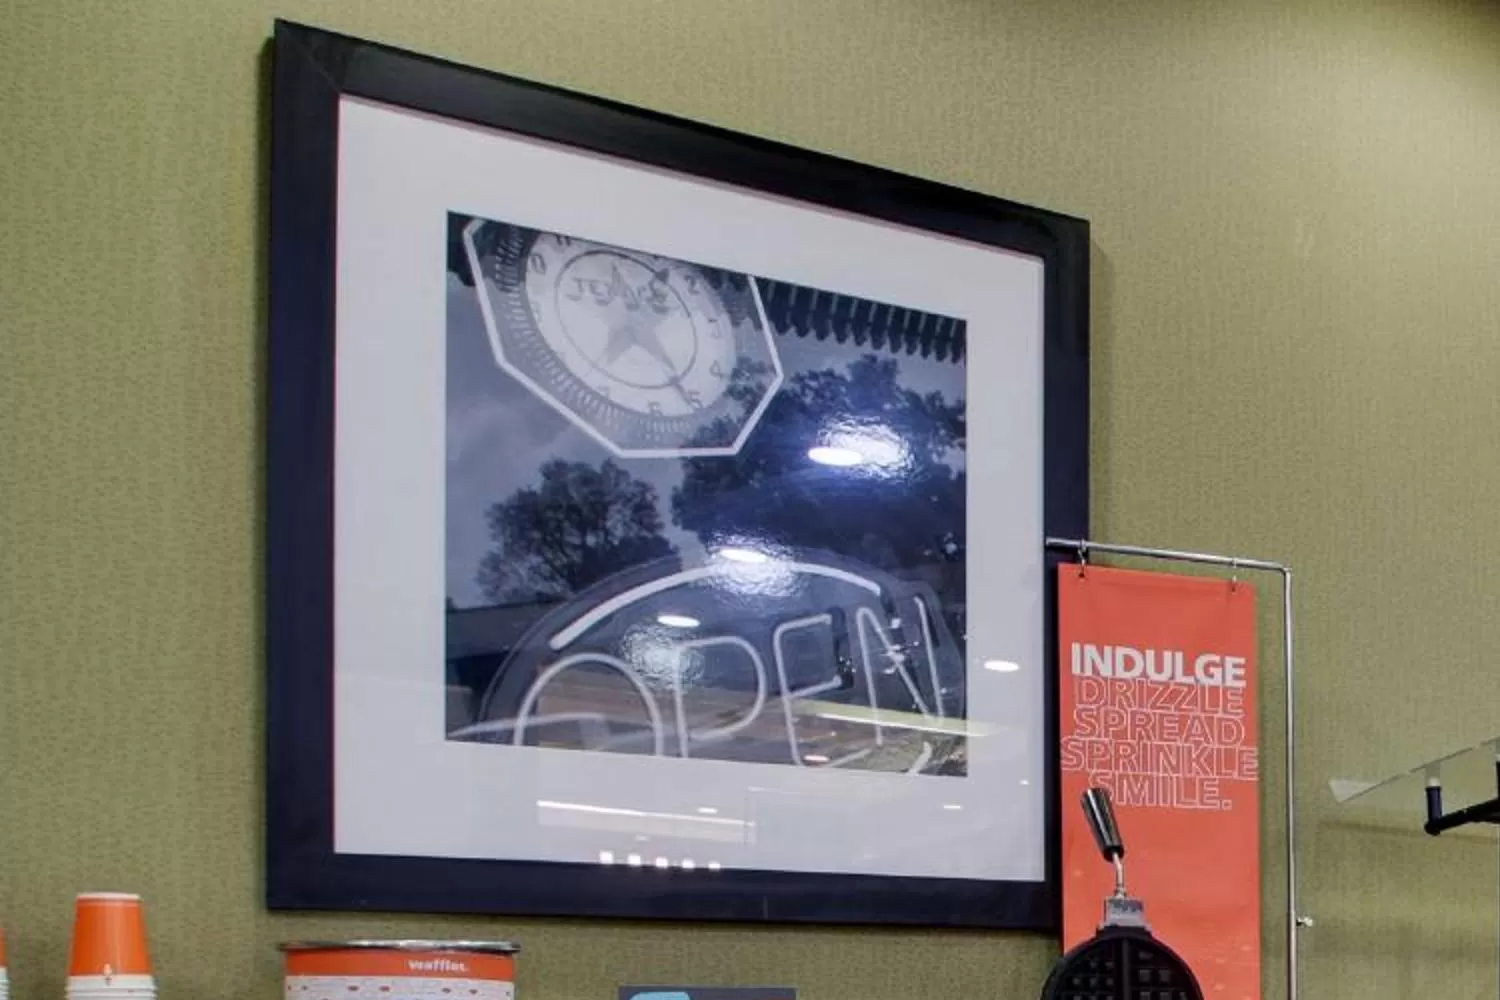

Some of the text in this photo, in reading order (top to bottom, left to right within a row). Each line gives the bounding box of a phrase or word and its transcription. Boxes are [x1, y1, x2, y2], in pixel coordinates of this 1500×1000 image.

[1071, 642, 1247, 688] INDULGE
[1076, 677, 1246, 718] DRIZZLE
[1073, 704, 1245, 747] SPREAD
[1060, 735, 1260, 781] SPRINKLE
[1088, 769, 1233, 811] SMILE.
